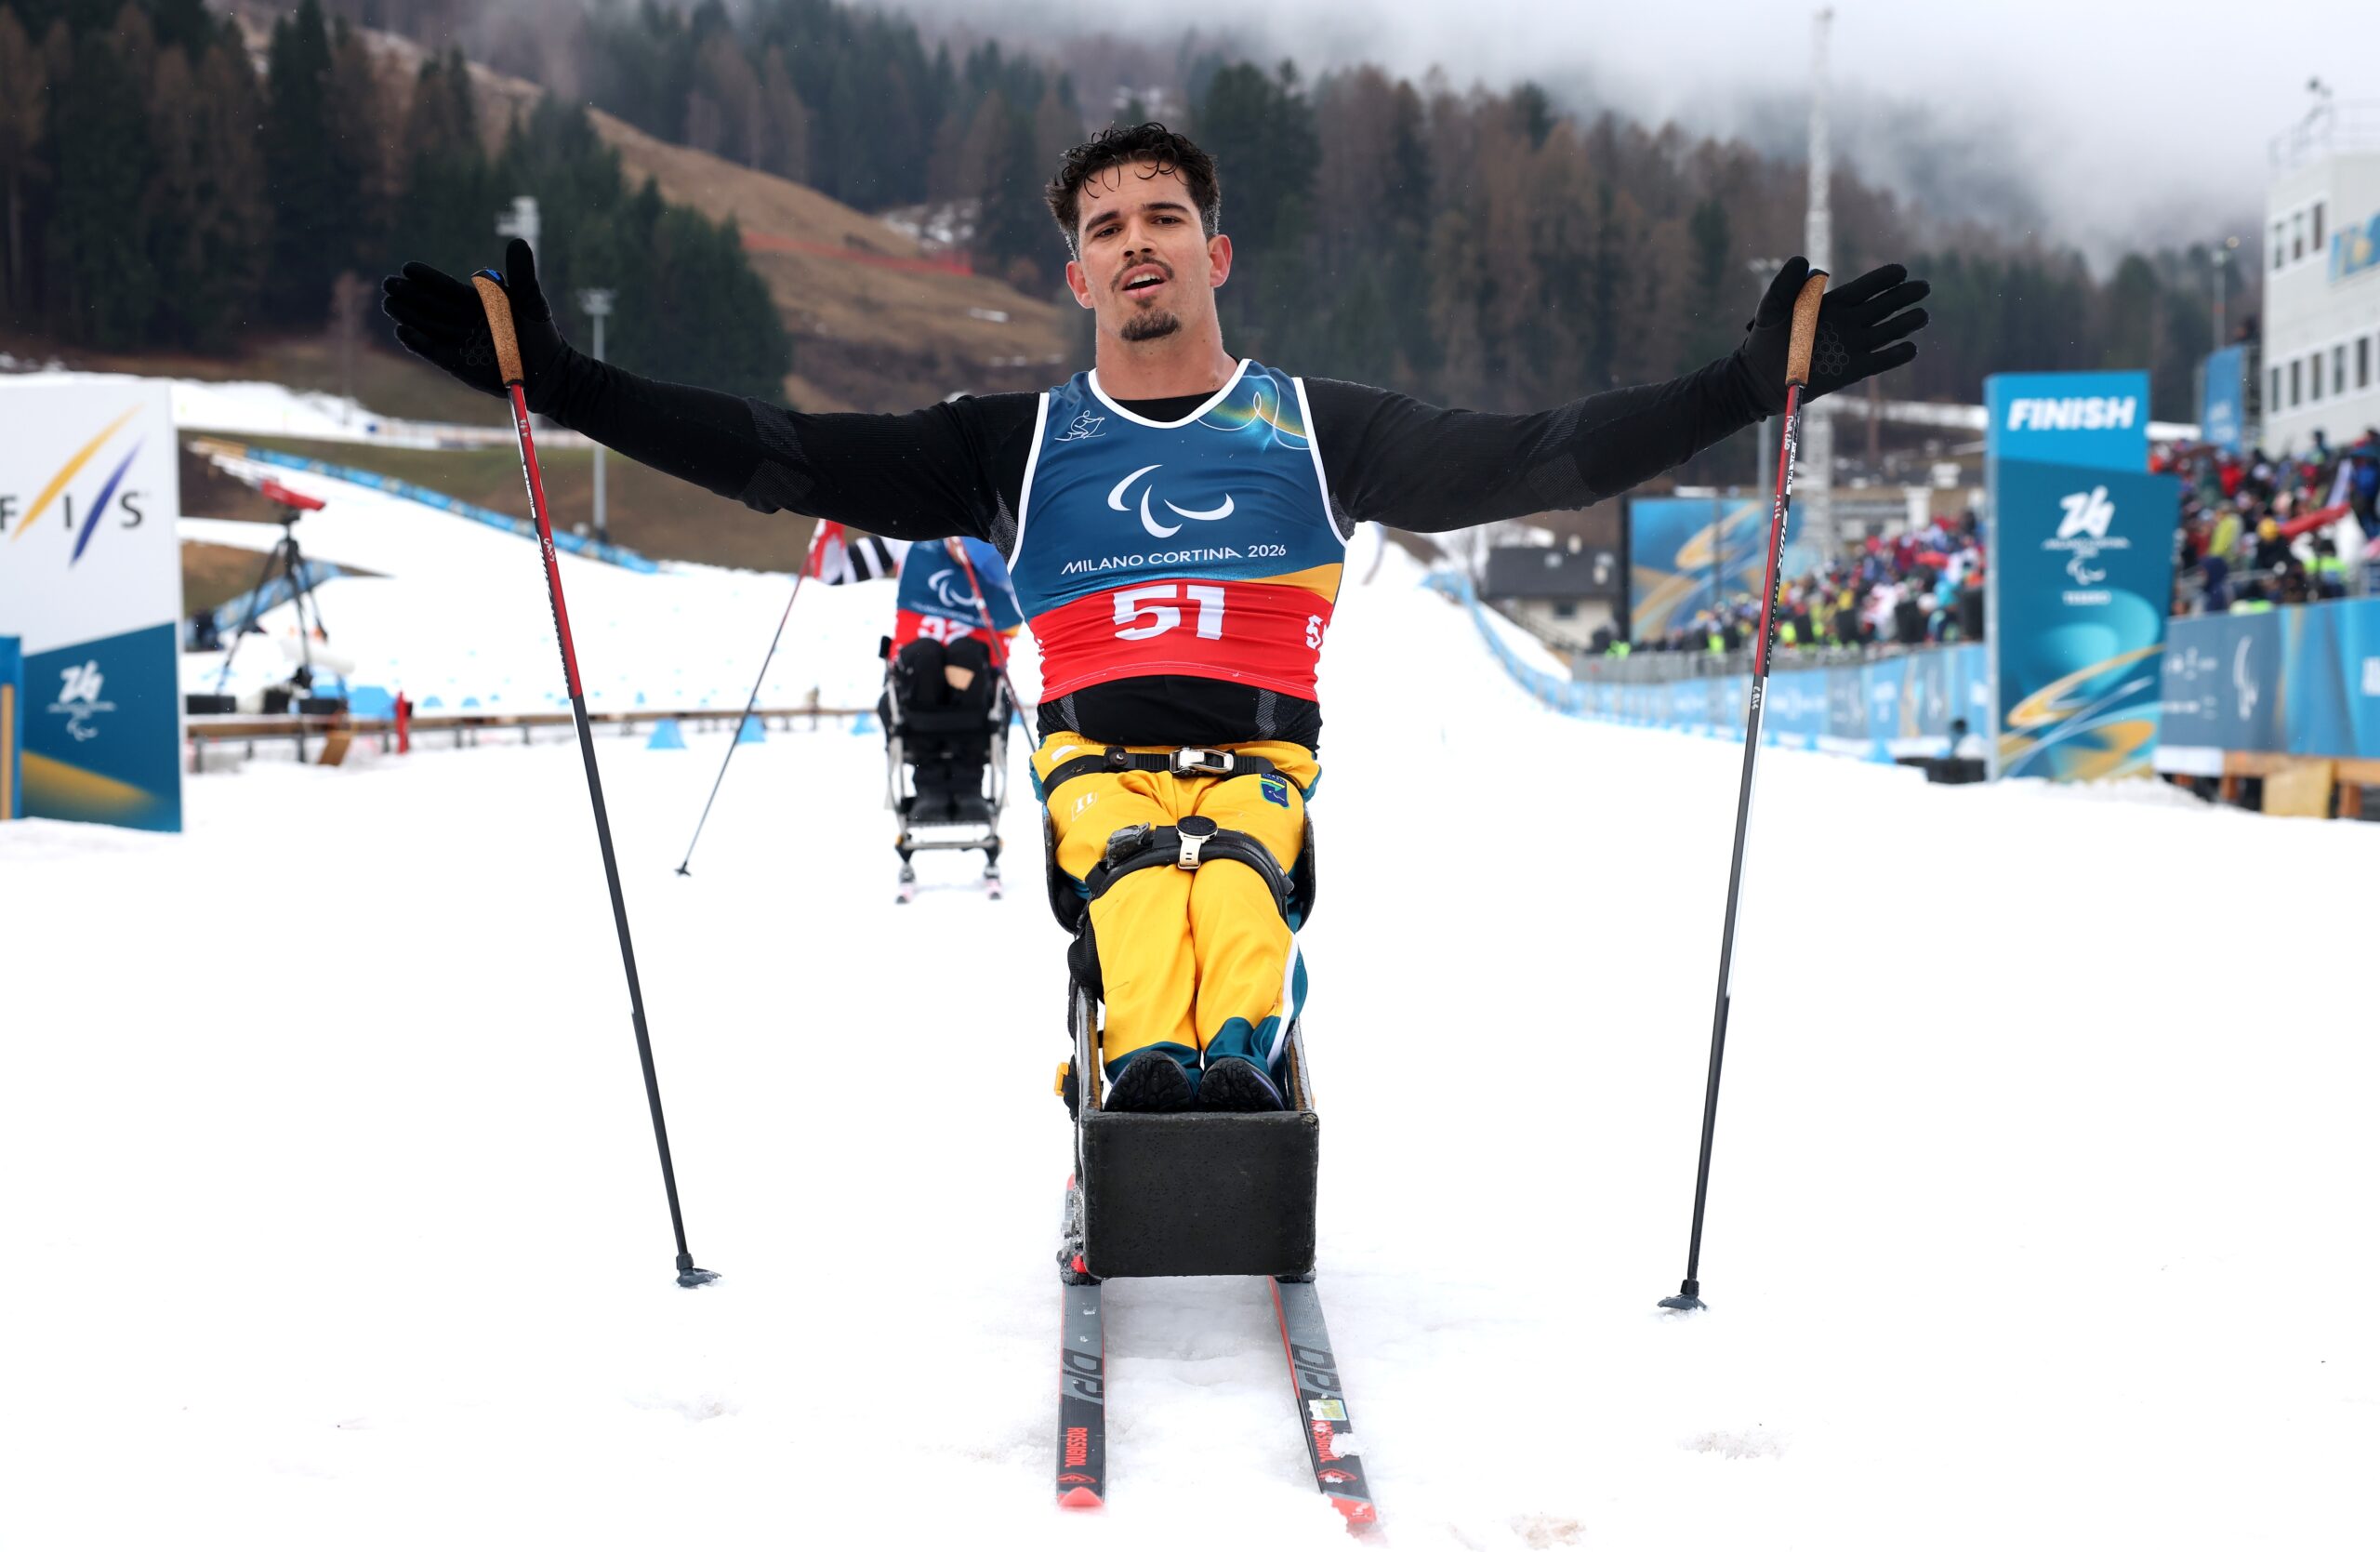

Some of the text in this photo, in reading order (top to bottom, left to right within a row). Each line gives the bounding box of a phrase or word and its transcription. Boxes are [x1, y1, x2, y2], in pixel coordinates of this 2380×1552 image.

[2007, 395, 2136, 431] FINISH
[0, 492, 143, 531] FIS
[1060, 543, 1288, 576] MILANO CORTINA 2026
[1112, 584, 1225, 641] 51
[1305, 614, 1327, 650] 5
[1064, 1426, 1088, 1468] ROSSIGNOL
